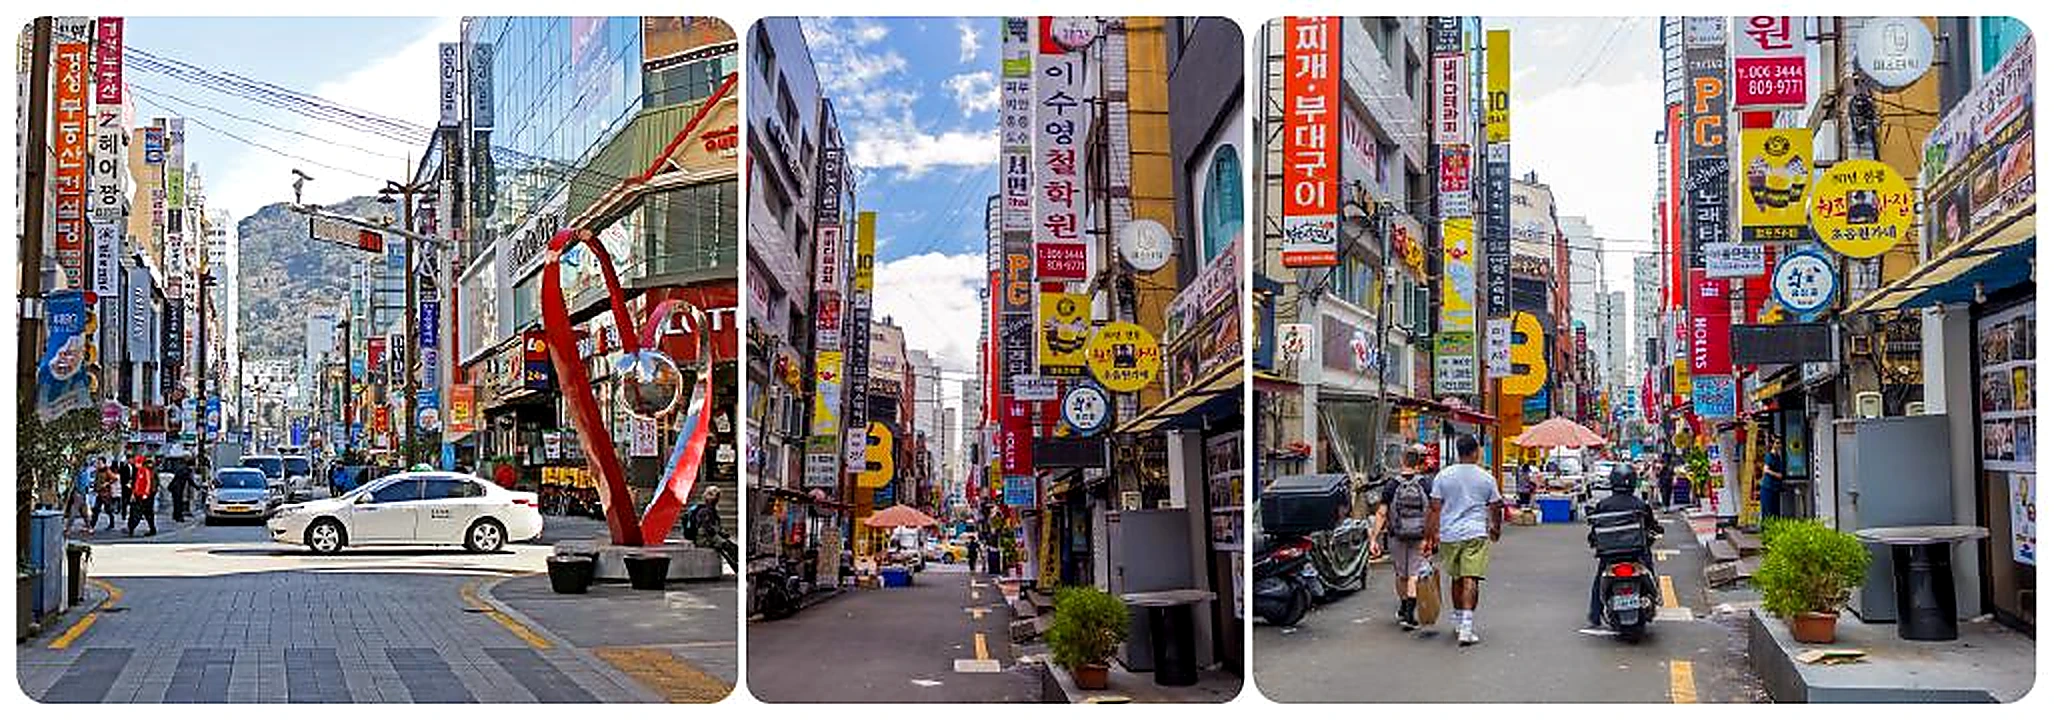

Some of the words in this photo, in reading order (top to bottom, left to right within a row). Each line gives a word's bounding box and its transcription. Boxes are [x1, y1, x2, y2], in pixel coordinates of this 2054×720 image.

[61, 52, 81, 93] 경성
[59, 98, 82, 168] 부동산
[1695, 317, 1707, 369] HOLLYS
